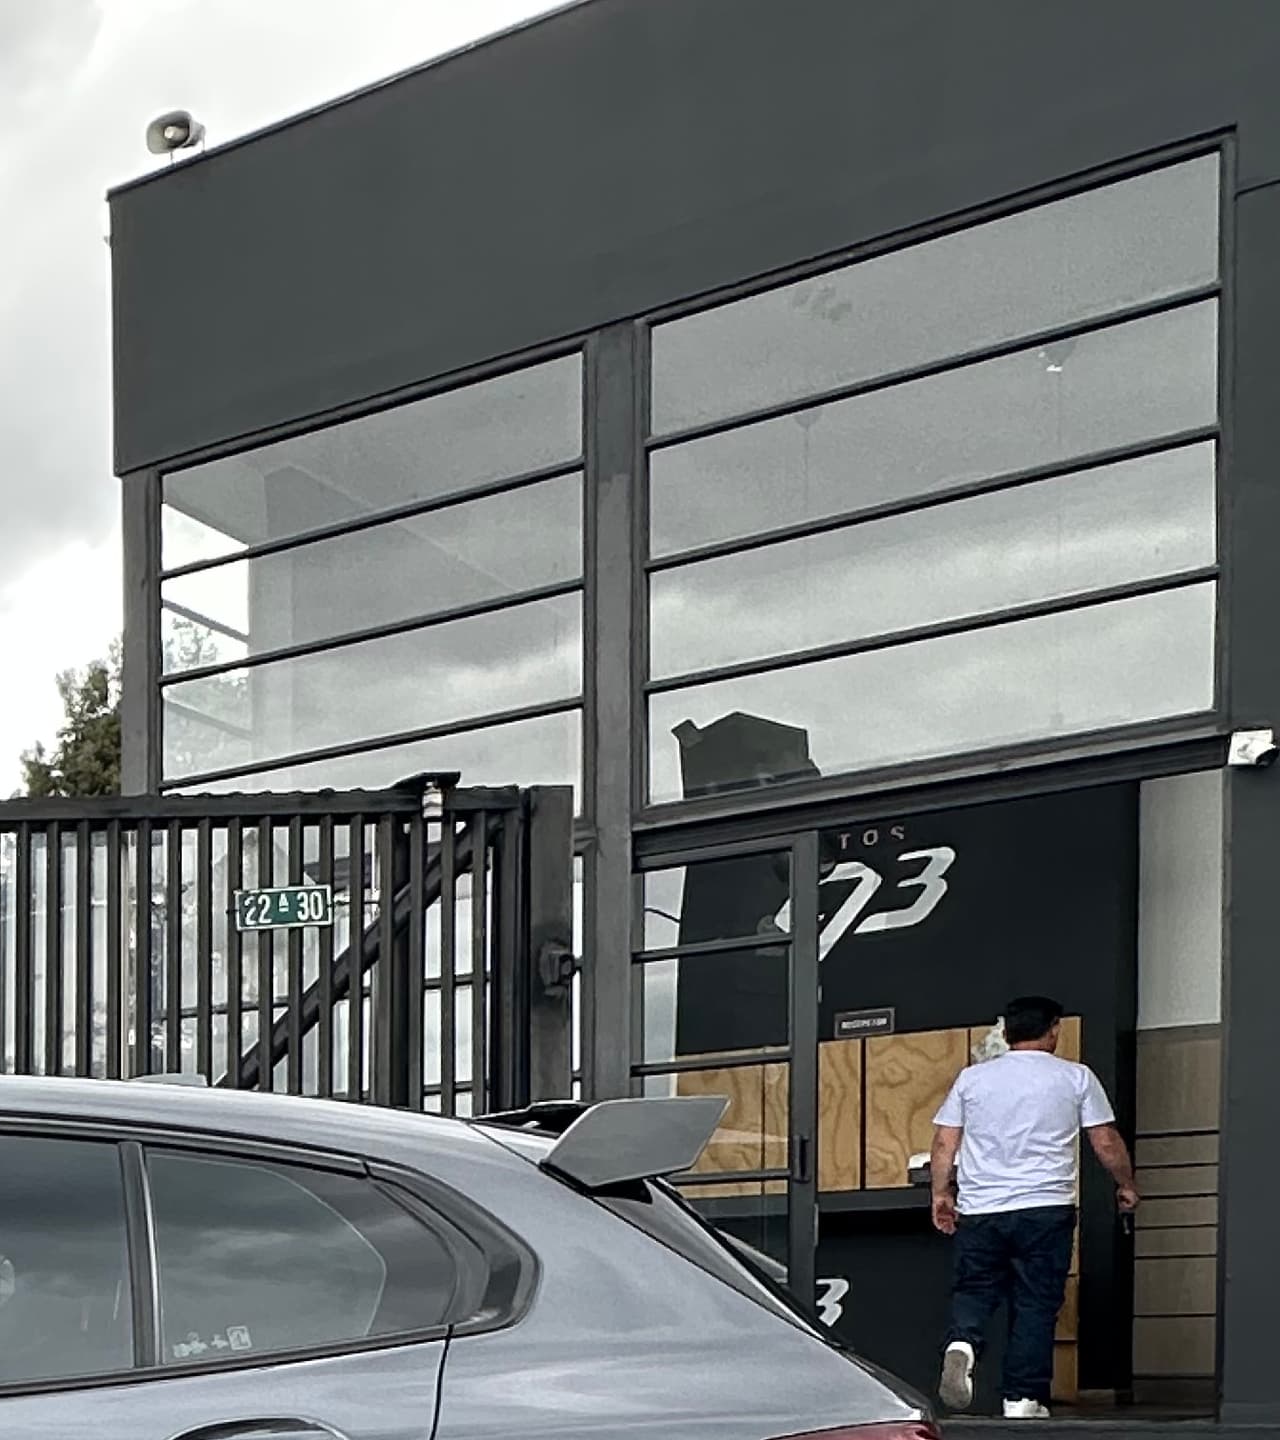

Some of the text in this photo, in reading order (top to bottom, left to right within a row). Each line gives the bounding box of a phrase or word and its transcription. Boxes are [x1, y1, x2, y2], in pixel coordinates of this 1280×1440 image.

[839, 825, 905, 850] TOS
[244, 895, 272, 926] 22
[297, 891, 324, 921] 30
